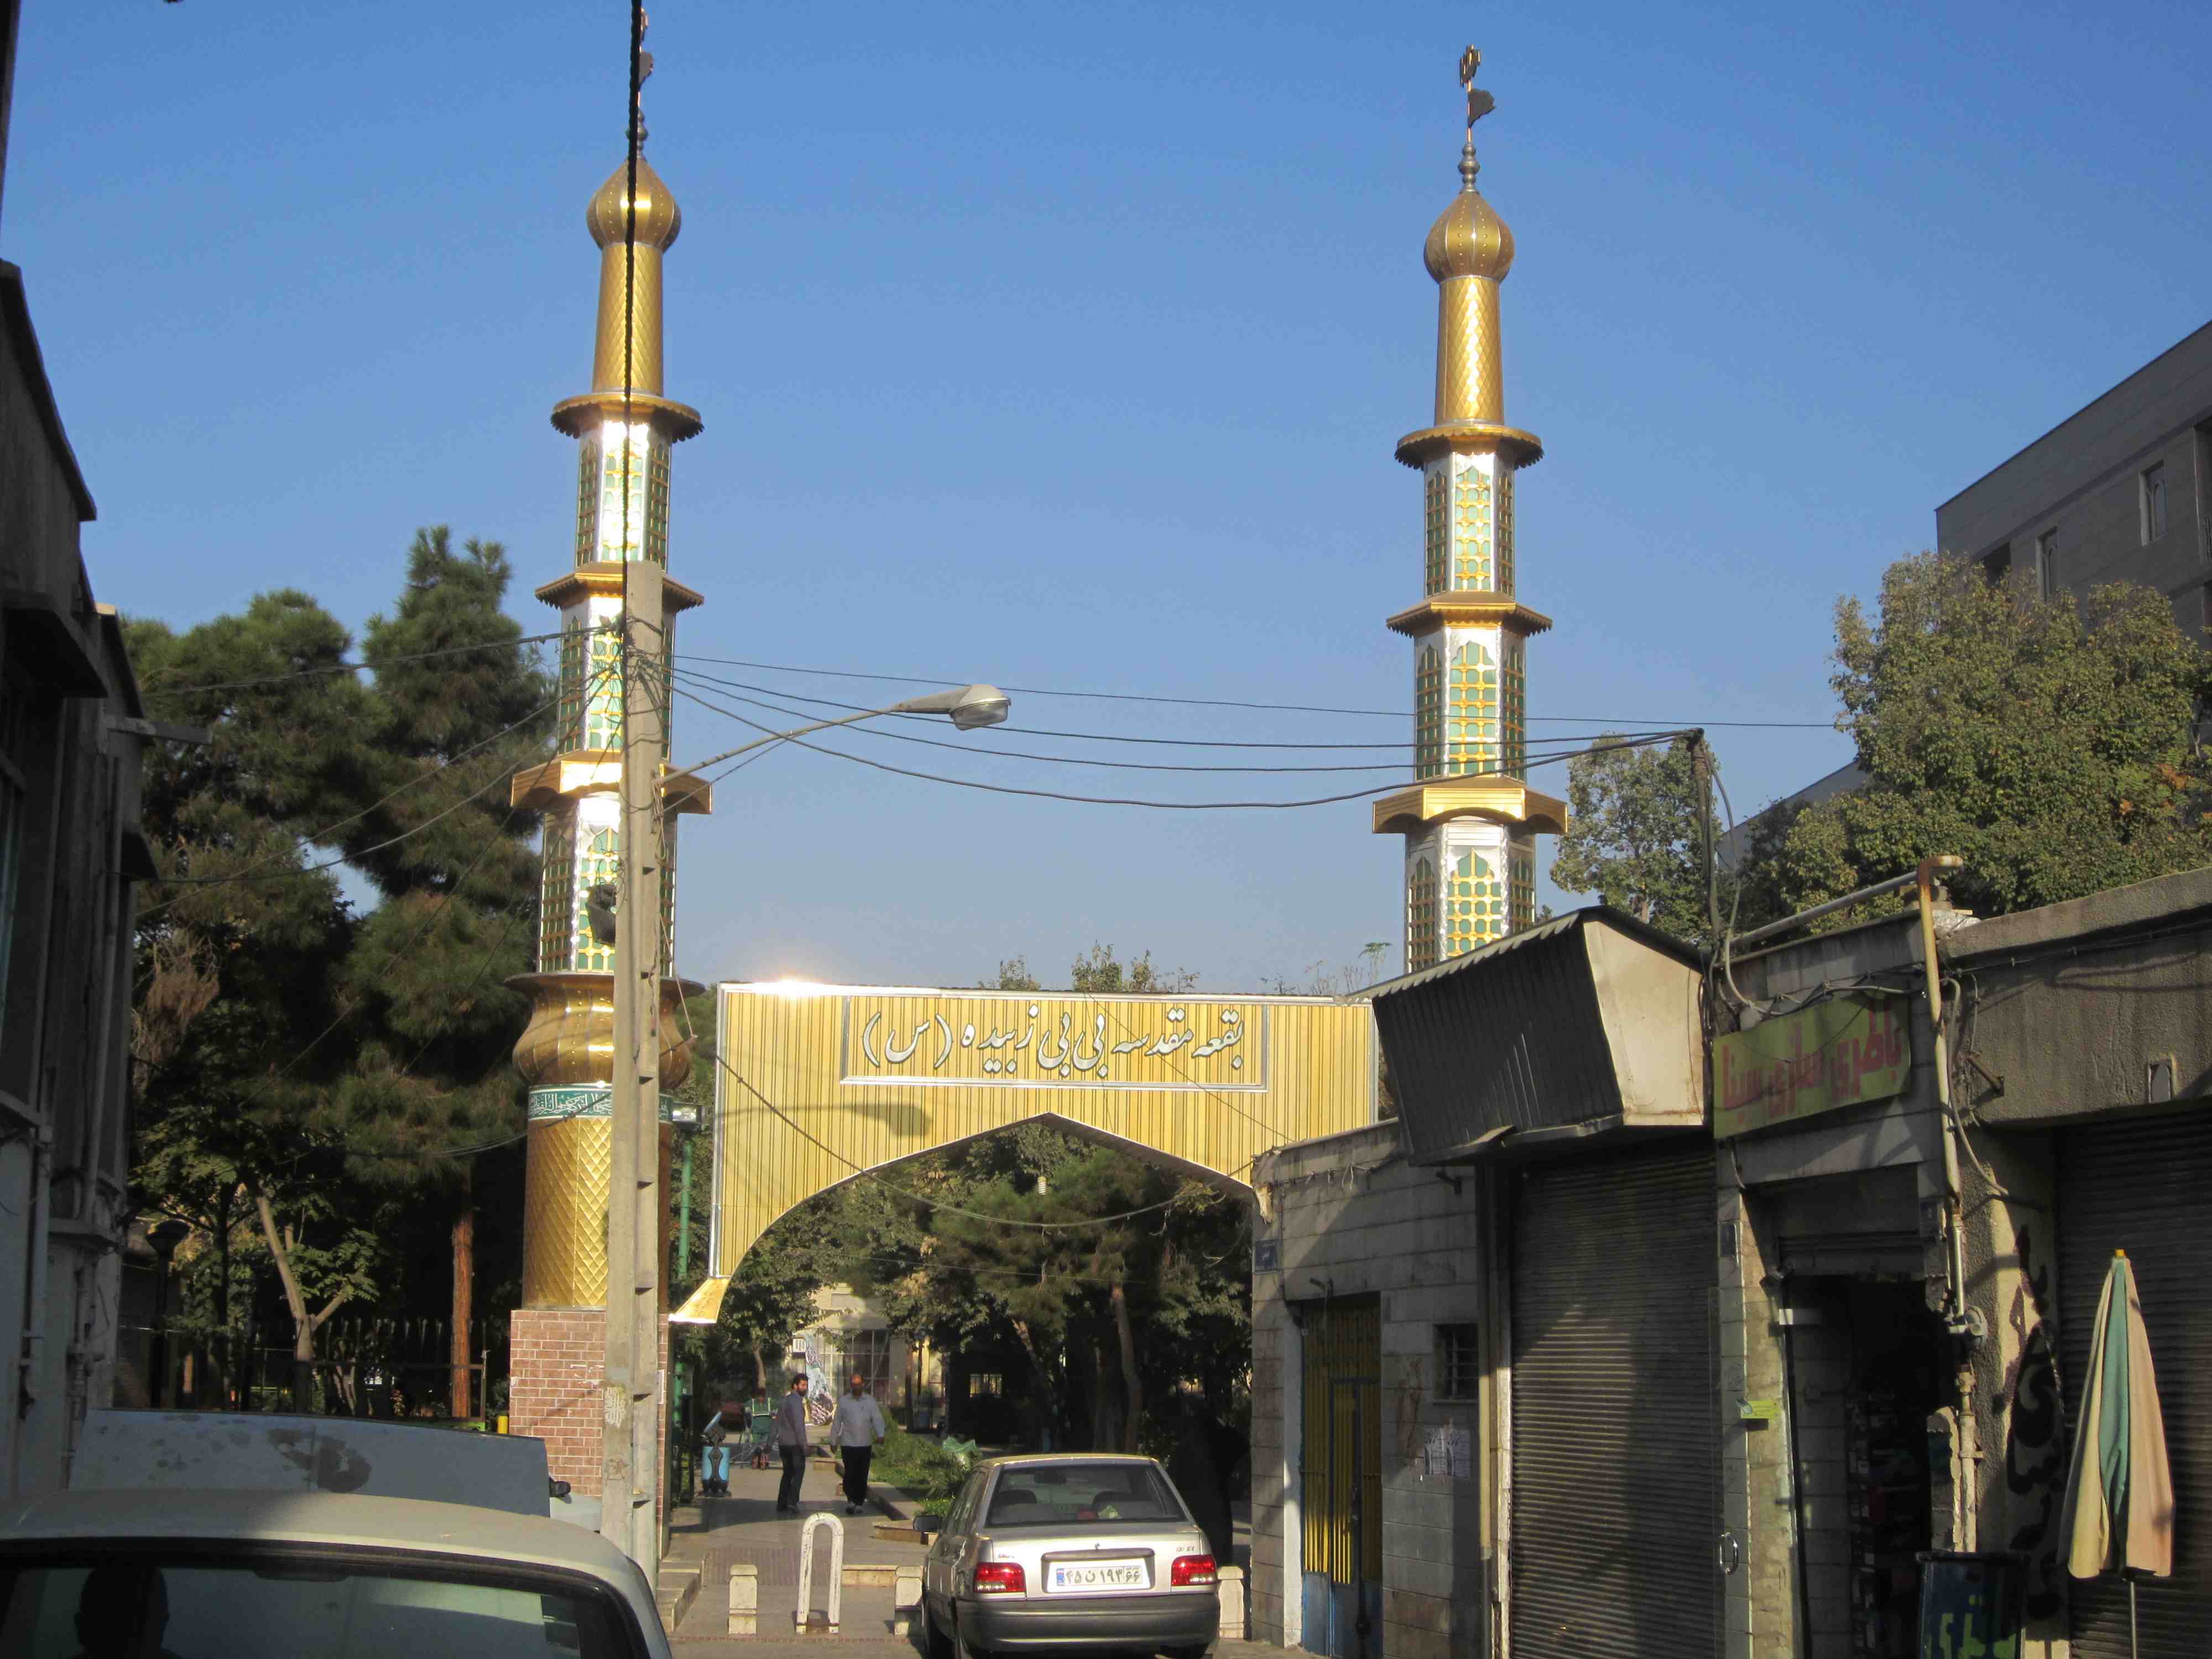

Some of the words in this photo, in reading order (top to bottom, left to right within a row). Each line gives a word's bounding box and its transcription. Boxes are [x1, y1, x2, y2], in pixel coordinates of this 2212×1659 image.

[961, 1003, 1039, 1074] زبیده
[1038, 1011, 1071, 1078] بی
[1072, 1013, 1109, 1078] بی
[1110, 1007, 1194, 1057] مقدسه
[1191, 1008, 1244, 1070] بقعه
